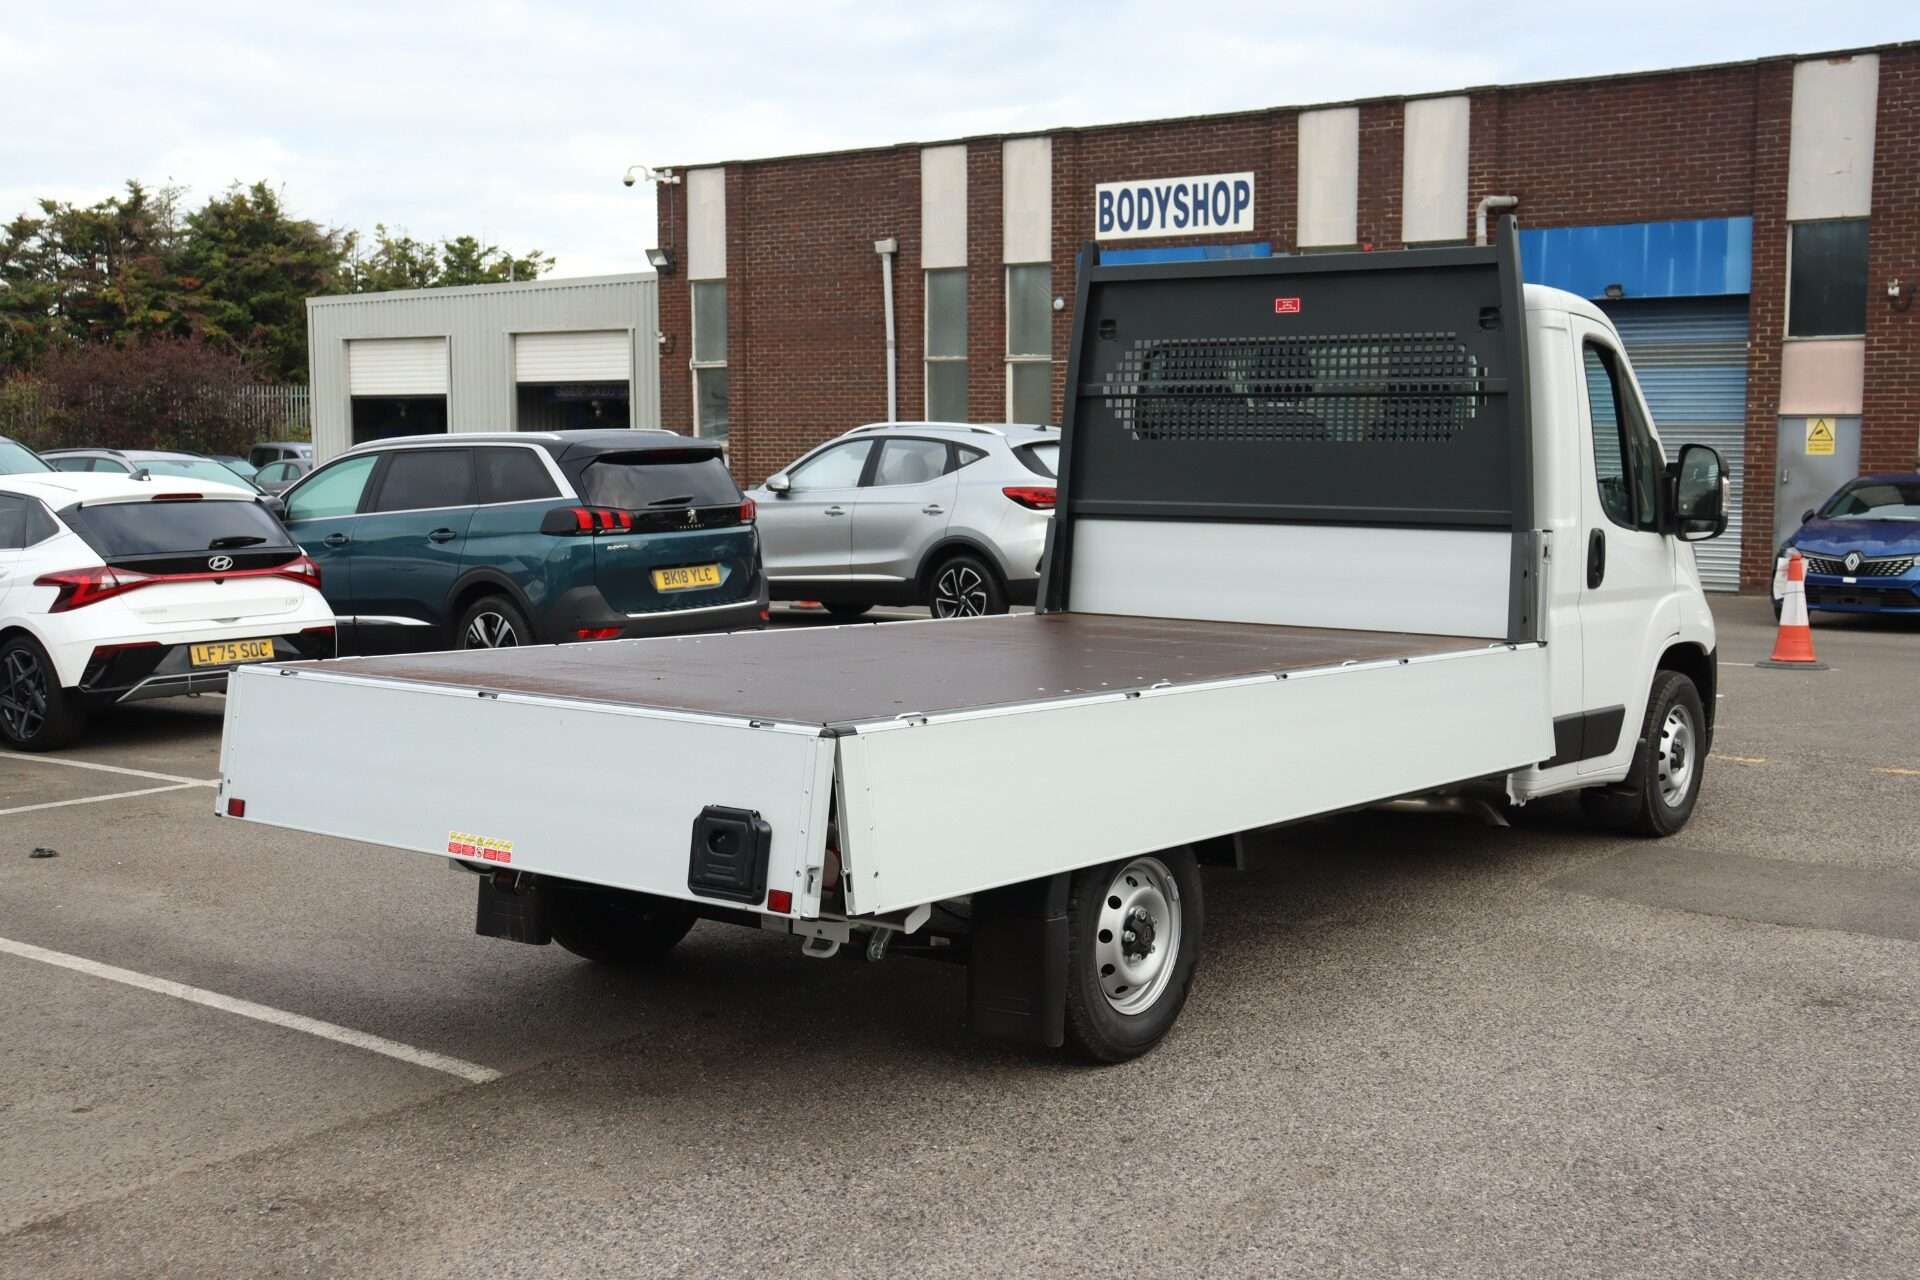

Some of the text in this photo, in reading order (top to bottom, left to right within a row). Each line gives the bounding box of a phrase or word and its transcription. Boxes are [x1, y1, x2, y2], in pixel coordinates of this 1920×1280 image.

[1099, 180, 1250, 232] BODYSHOP
[662, 567, 713, 585] BK18 YLC
[196, 642, 269, 662] LF75 SOC
